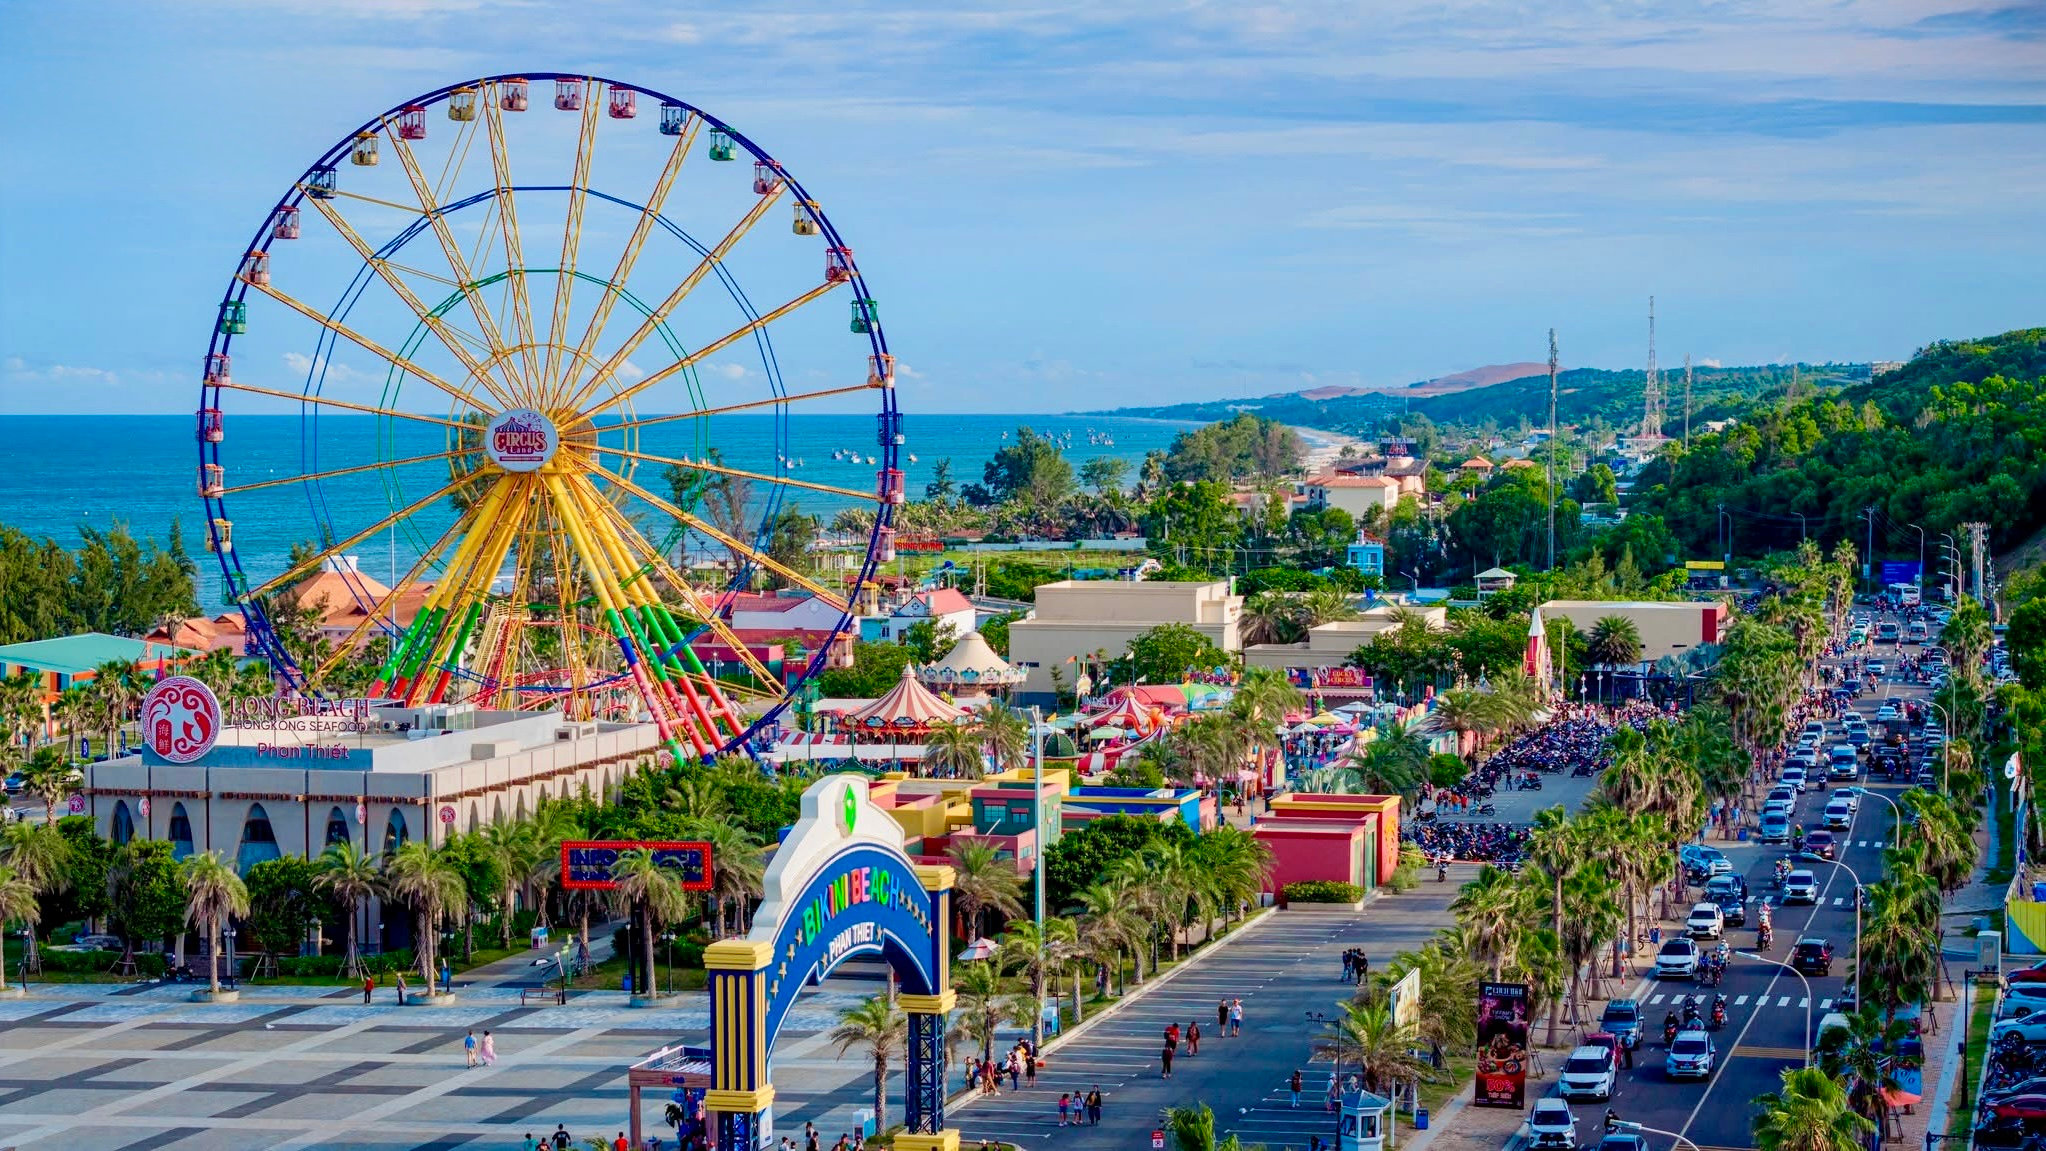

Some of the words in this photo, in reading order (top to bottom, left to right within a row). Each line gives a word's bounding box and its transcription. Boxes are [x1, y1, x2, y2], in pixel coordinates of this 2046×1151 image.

[493, 431, 548, 453] CIRCUS
[510, 446, 532, 454] Land
[229, 696, 291, 717] LONG
[296, 697, 370, 718] BEACH
[235, 720, 306, 731] HONGKONG
[309, 721, 368, 733] SEAFOOD
[258, 742, 302, 758] Phan
[306, 742, 349, 760] Thiết
[802, 873, 849, 946] BIKINI
[850, 866, 900, 911] BEACH
[829, 928, 852, 961] PHAN
[853, 922, 875, 943] THIET
[1486, 1078, 1515, 1093] 50%
